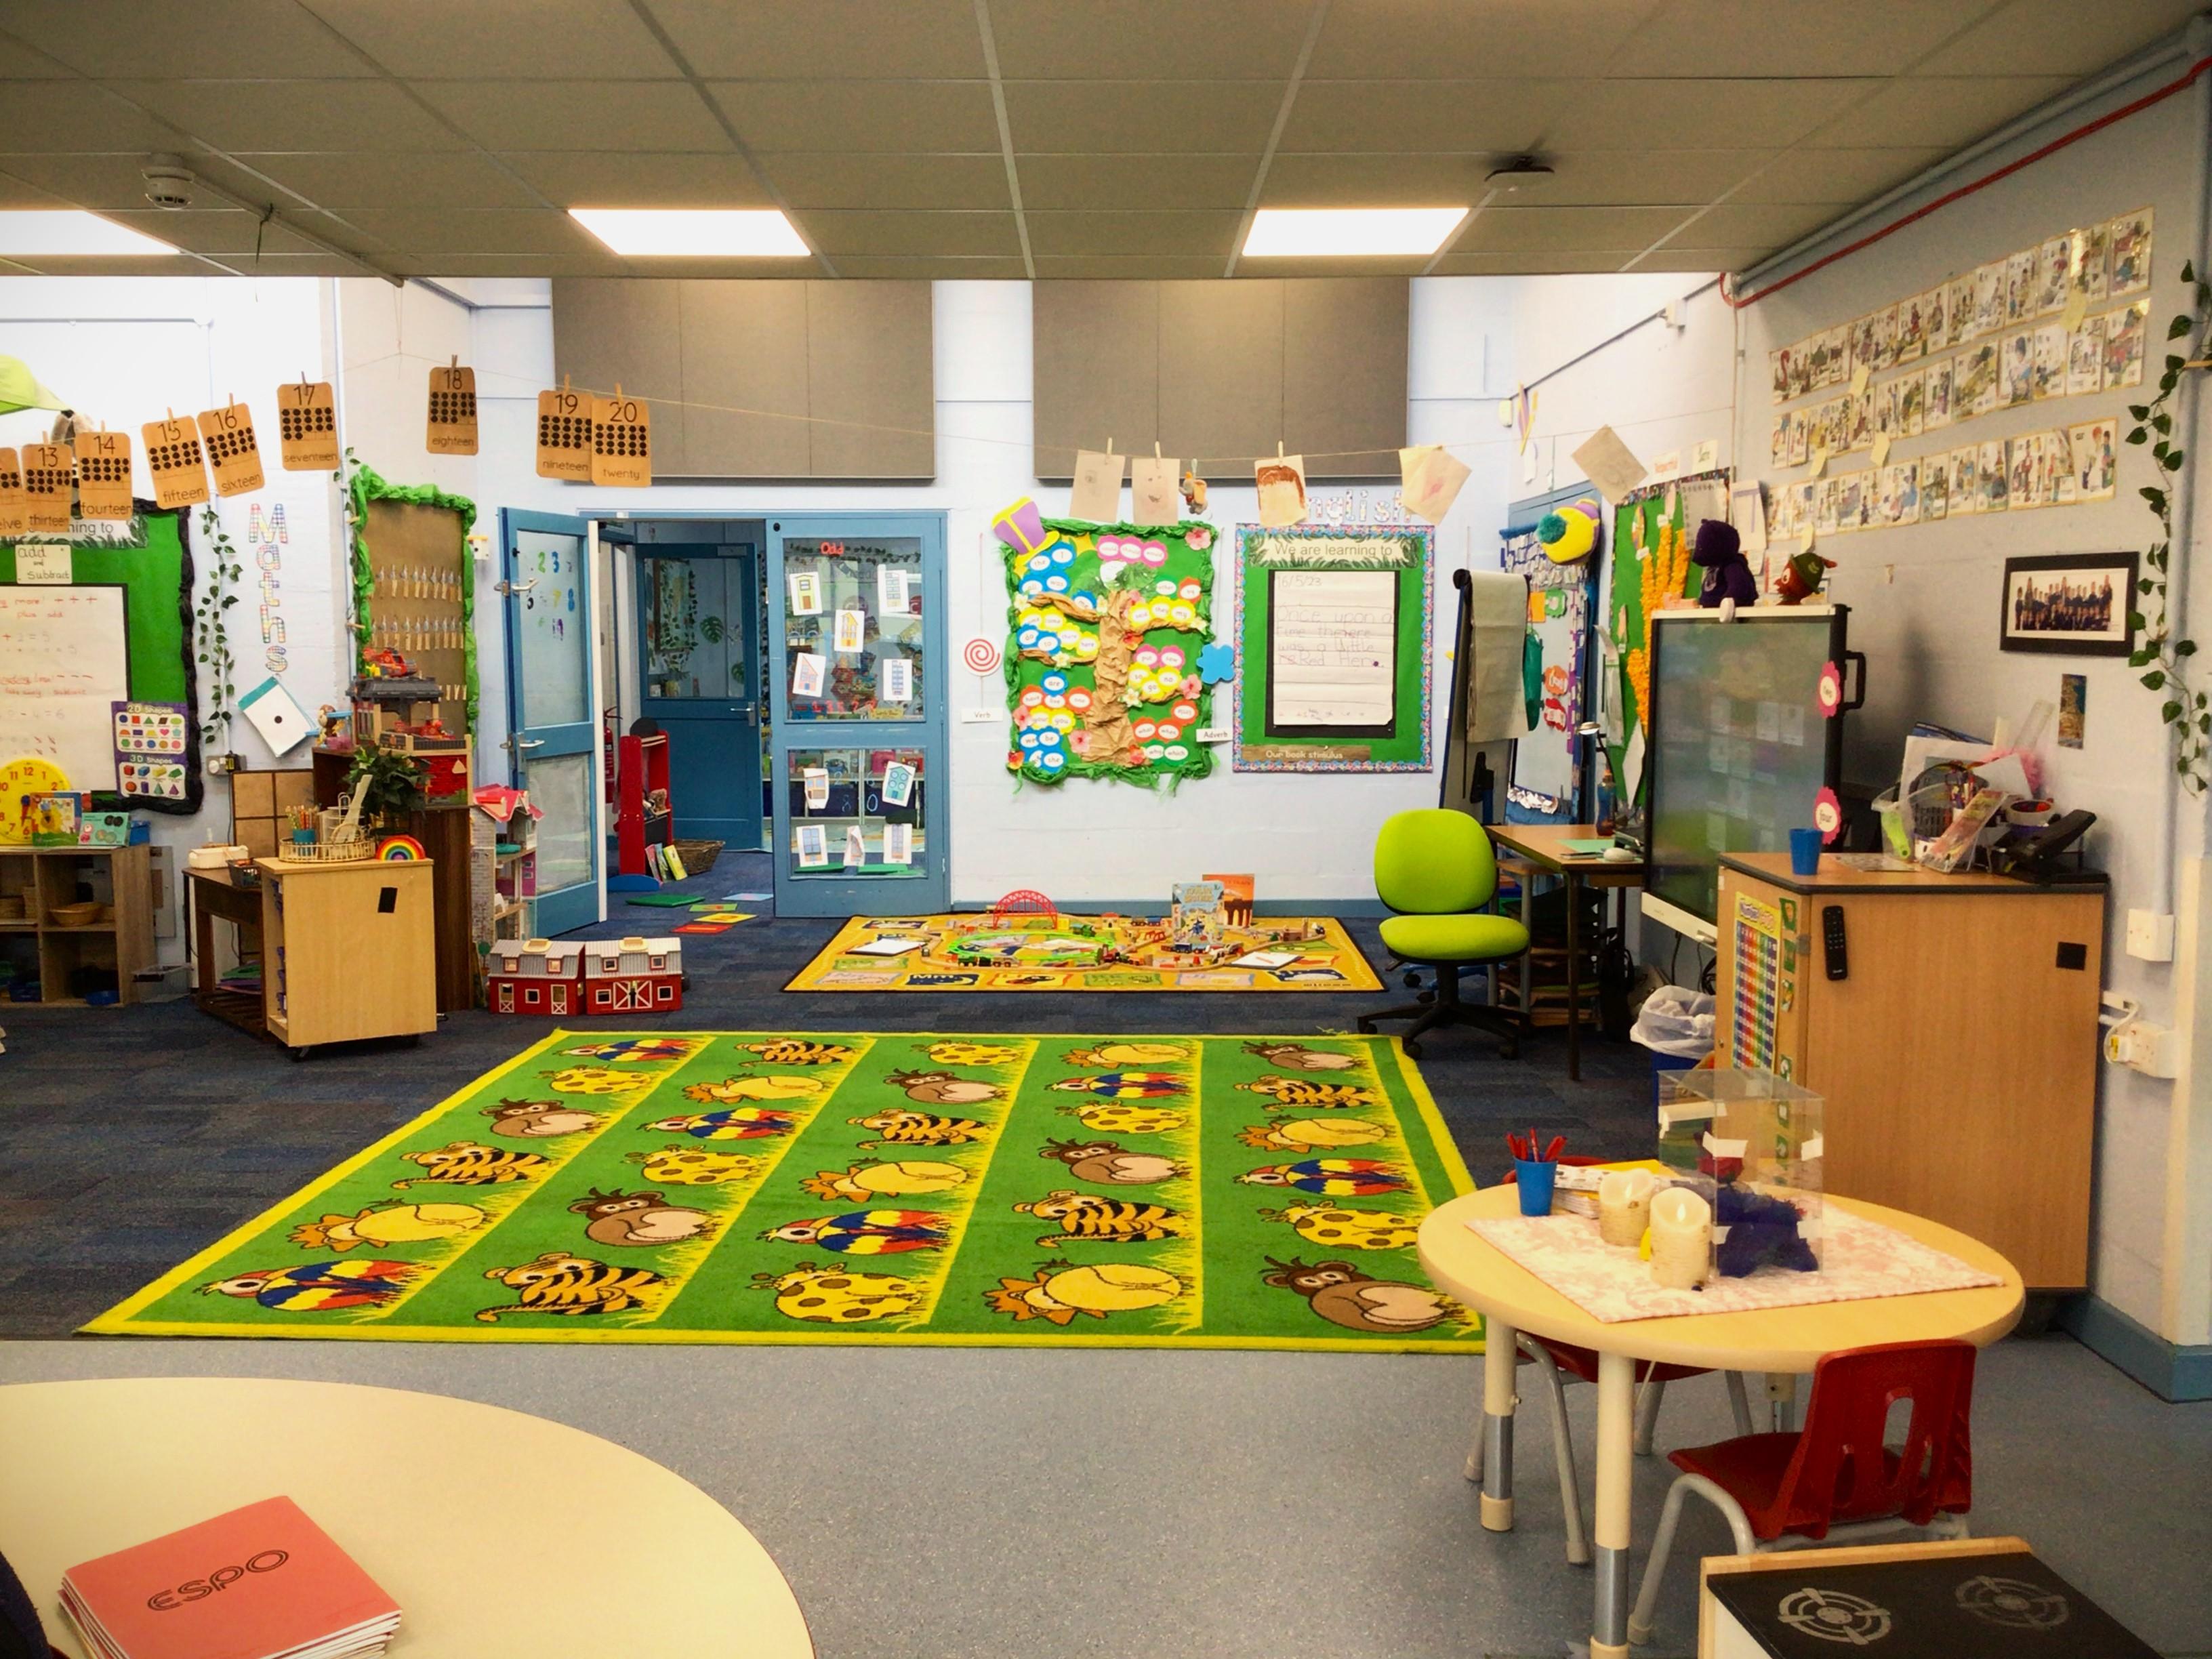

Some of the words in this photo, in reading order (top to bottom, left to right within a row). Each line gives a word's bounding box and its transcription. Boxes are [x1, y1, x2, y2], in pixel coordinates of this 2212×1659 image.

[443, 370, 462, 390] 18
[293, 385, 315, 405] 17
[555, 394, 578, 415] 19
[609, 403, 638, 423] 20
[213, 409, 237, 430] 16
[158, 421, 182, 442] 15
[94, 436, 115, 455] 14
[432, 436, 473, 448] eighteen
[38, 447, 58, 468] 13
[285, 453, 337, 462] seventeen
[543, 460, 588, 472] nineteen
[603, 468, 640, 480] twenty
[221, 474, 260, 492] sixteen
[163, 488, 204, 503] fifteen
[81, 502, 132, 514] fourteen
[1308, 489, 1412, 527] nglish
[28, 514, 69, 526] thirteen
[102, 523, 114, 532] to
[18, 546, 46, 558] add
[820, 542, 844, 554] Odd
[1275, 544, 1296, 554] We
[1300, 546, 1321, 555] are
[1326, 544, 1376, 557] learning
[1381, 545, 1393, 555] to
[538, 552, 546, 573] 2
[552, 551, 559, 573] 3
[249, 504, 288, 672] Maths
[567, 588, 575, 612] 8
[127, 703, 143, 712] 2D
[130, 754, 144, 762] 3D
[1266, 750, 1284, 758] Our
[1286, 750, 1306, 758] book
[1309, 750, 1343, 759] stimulus
[9, 771, 18, 780] 11
[24, 766, 34, 776] 12
[42, 771, 46, 780] 1
[52, 782, 58, 791] 2
[9, 822, 16, 832] 7
[23, 825, 30, 835] 6
[147, 1549, 289, 1612] ESPO
